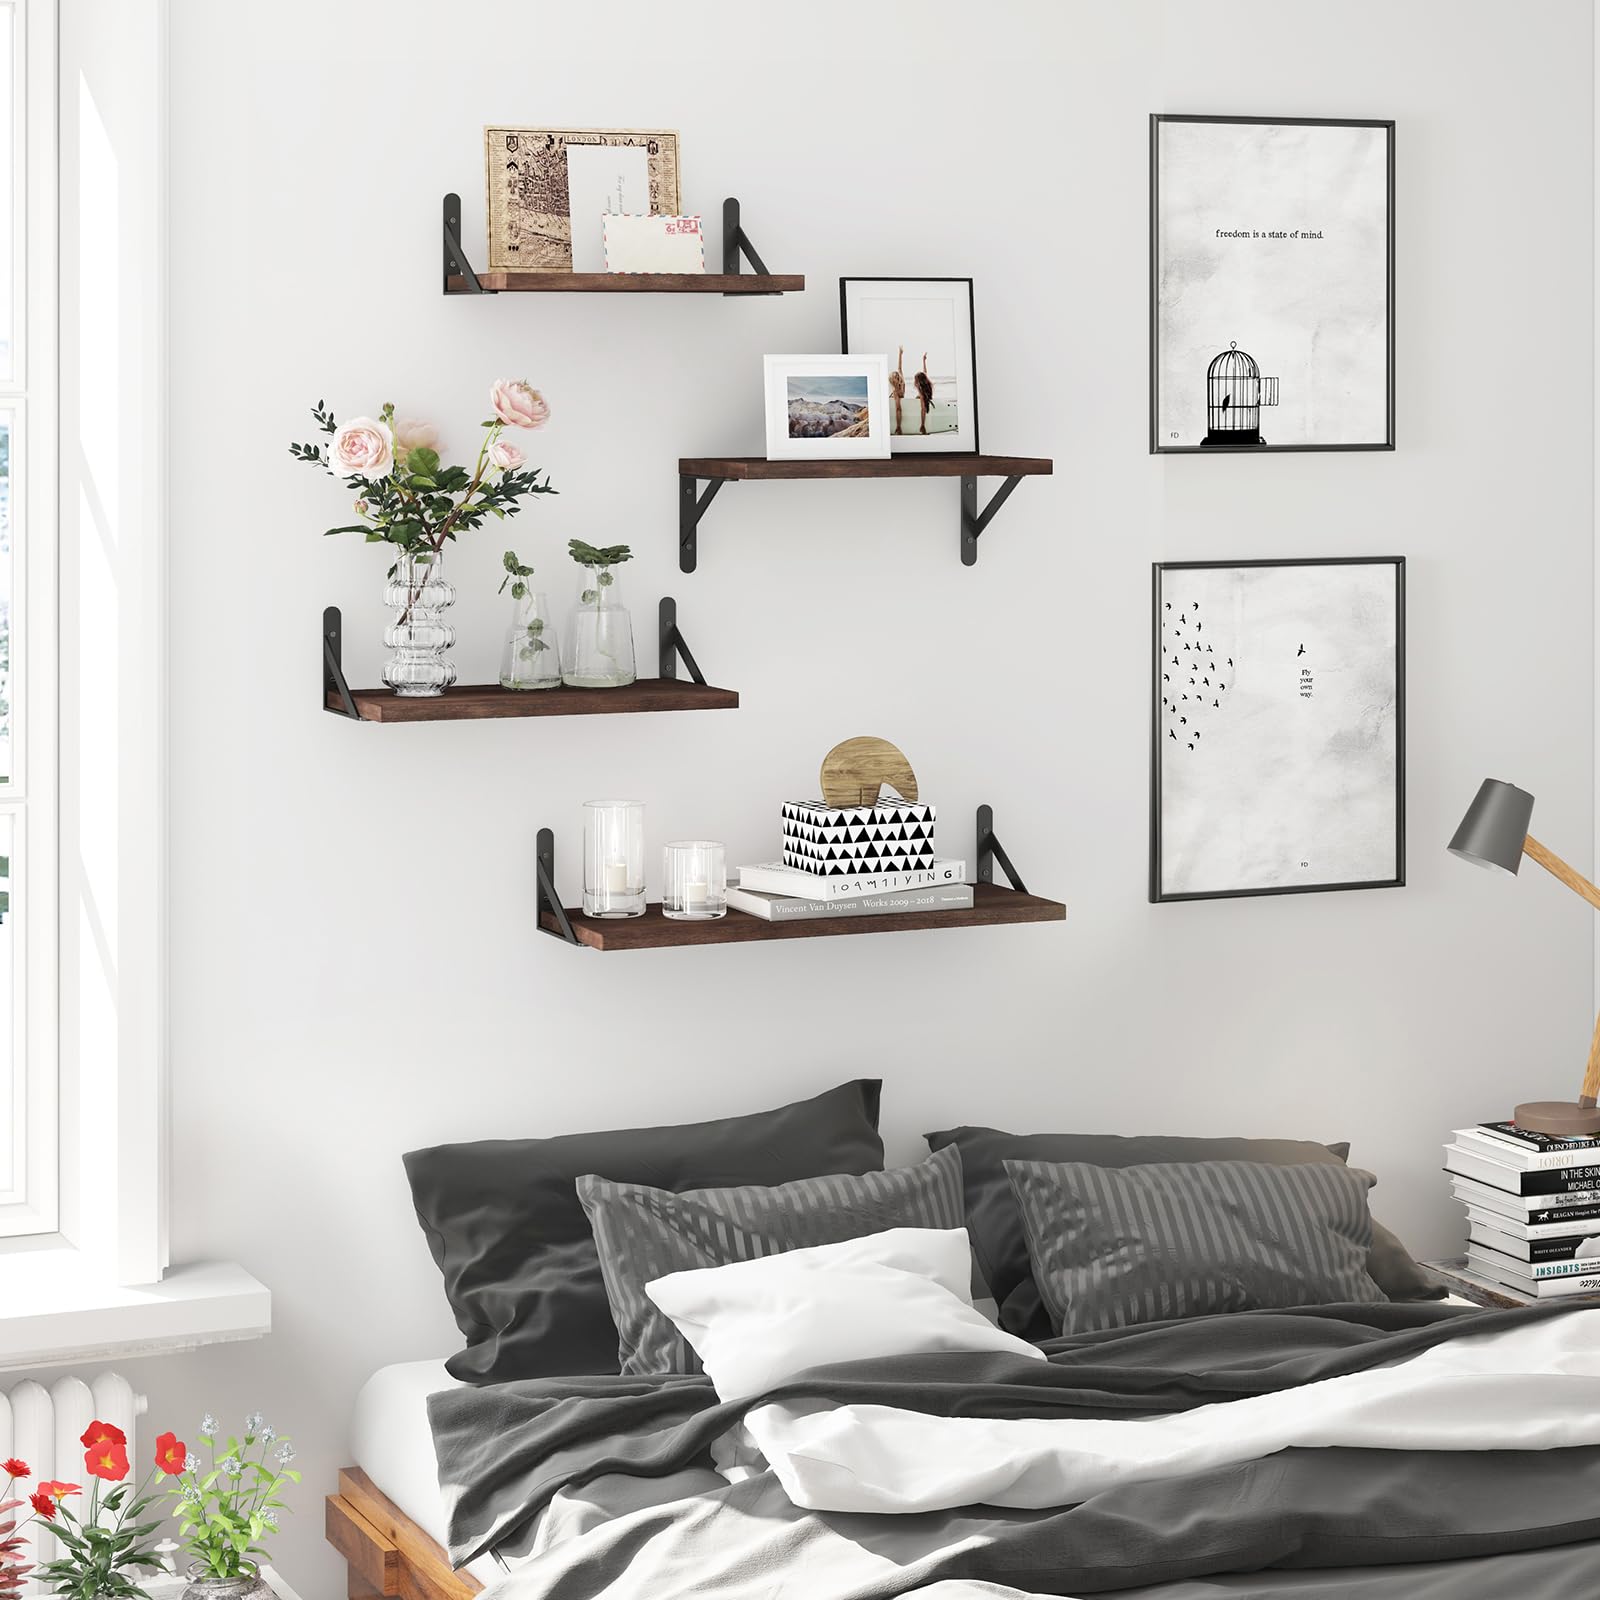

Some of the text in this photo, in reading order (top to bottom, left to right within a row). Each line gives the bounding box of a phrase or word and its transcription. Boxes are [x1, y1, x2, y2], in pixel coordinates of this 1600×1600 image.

[566, 135, 597, 143] LONDON
[1215, 229, 1250, 238] freedom
[1253, 229, 1260, 238] is
[1268, 231, 1288, 239] state
[1290, 230, 1299, 239] of
[1300, 230, 1324, 239] mind.
[775, 904, 807, 914] Vincent
[809, 903, 825, 912] Van
[826, 902, 857, 913] Duysen
[863, 899, 888, 908] Works
[889, 899, 909, 908] 2009
[916, 895, 935, 904] 2018
[1560, 1169, 1568, 1179] IN
[1570, 1168, 1583, 1178] THE
[1567, 1180, 1595, 1191] MICHAEL
[1552, 1210, 1574, 1219] REAGAN
[1536, 1263, 1580, 1277] INSIGHTS
